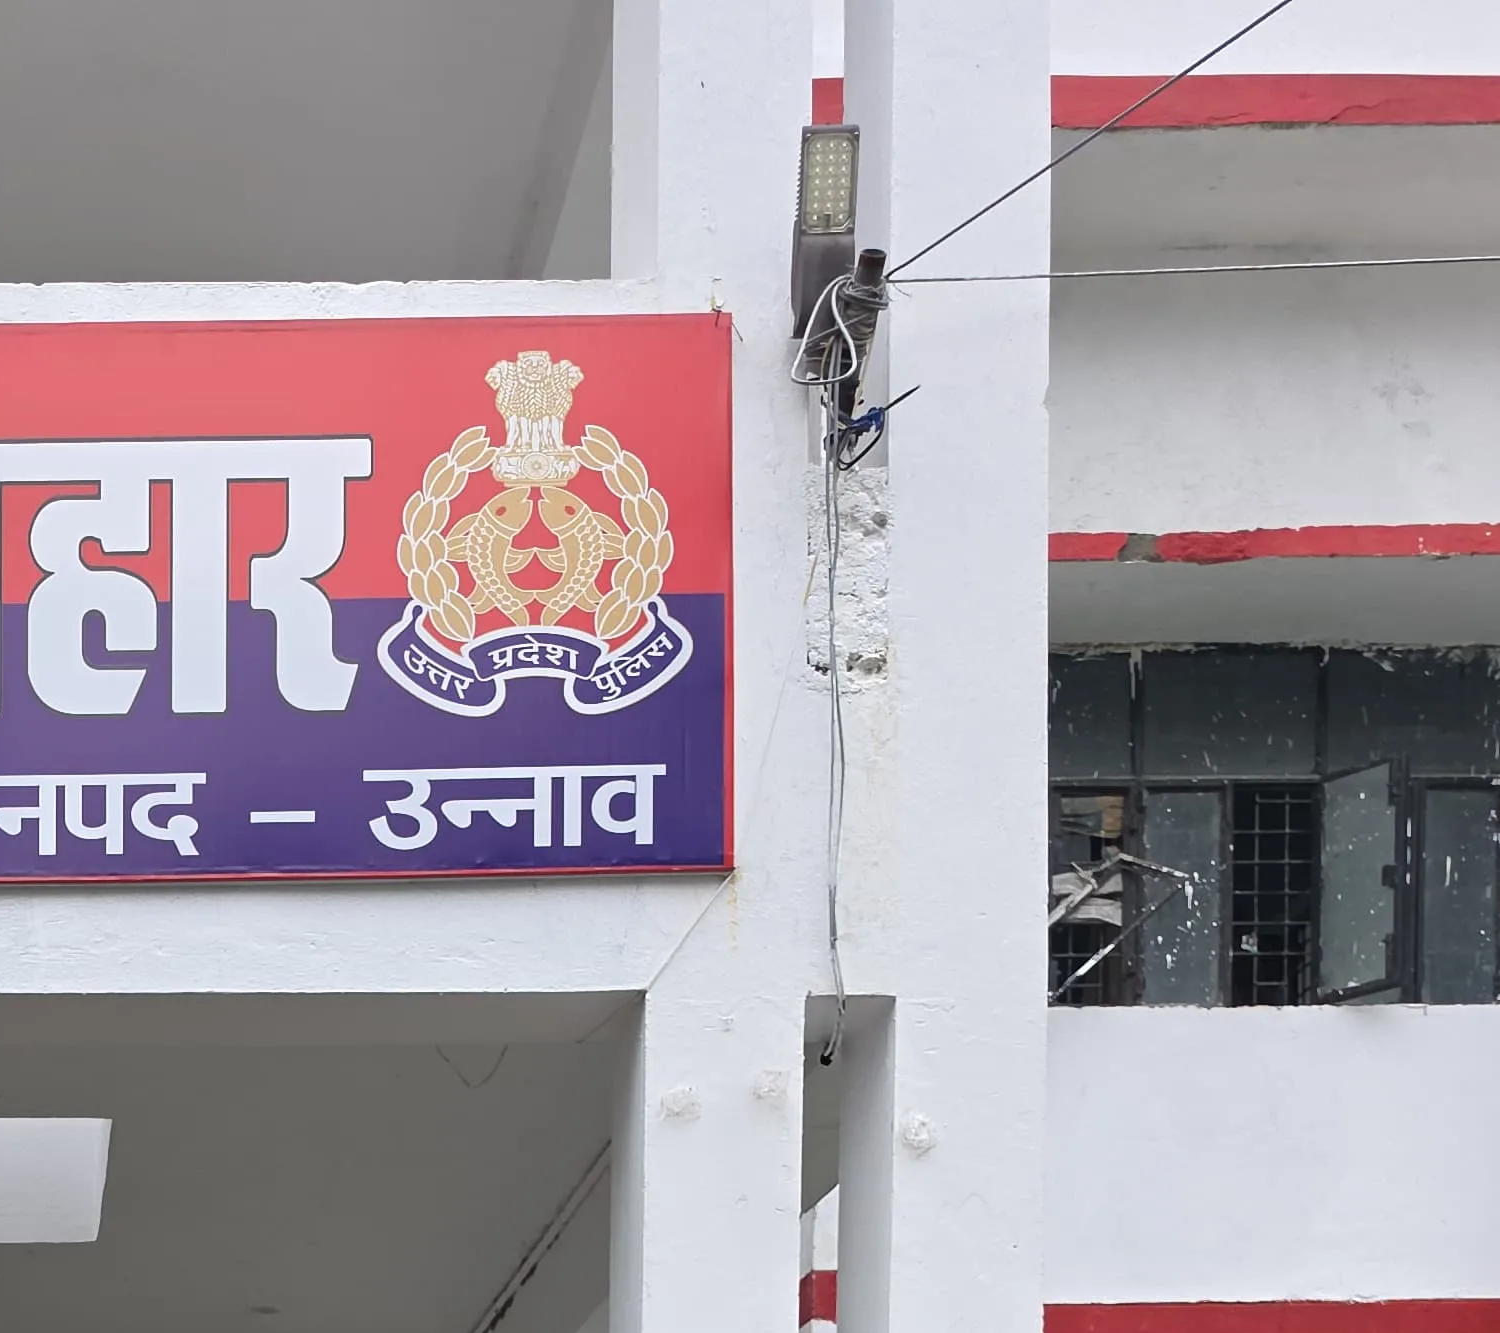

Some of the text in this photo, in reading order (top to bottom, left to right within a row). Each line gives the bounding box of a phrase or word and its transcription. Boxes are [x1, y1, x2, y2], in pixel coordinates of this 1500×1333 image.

[402, 630, 675, 704] उत्तर प्रदेश पुलिस
[362, 763, 667, 851] उन्नाव
